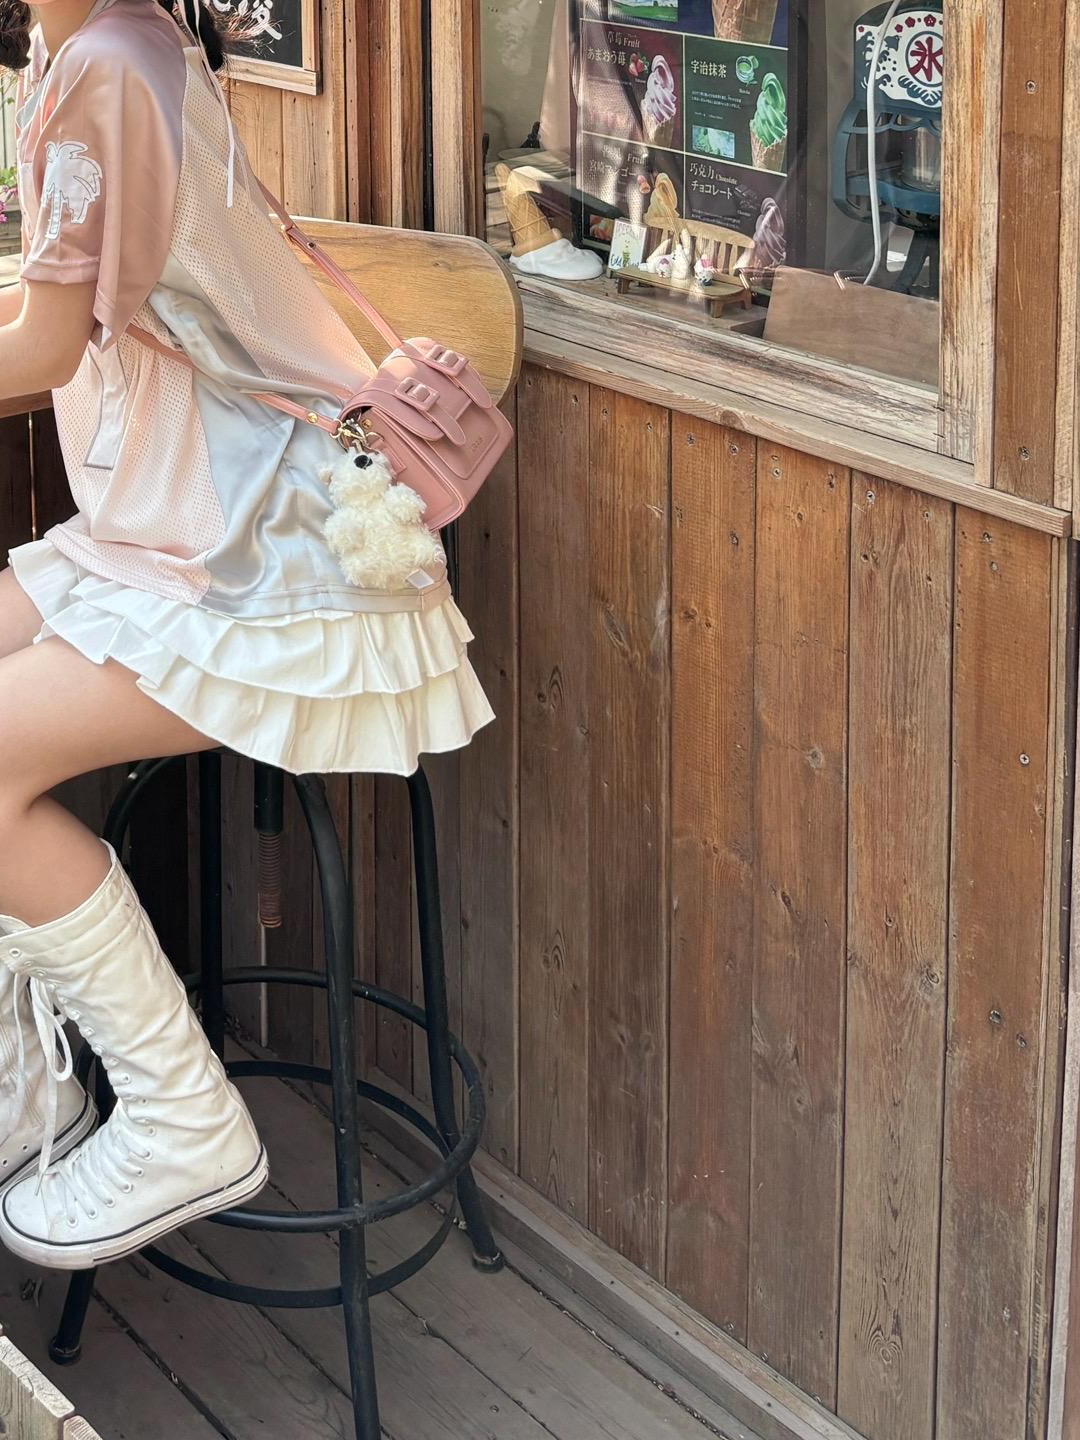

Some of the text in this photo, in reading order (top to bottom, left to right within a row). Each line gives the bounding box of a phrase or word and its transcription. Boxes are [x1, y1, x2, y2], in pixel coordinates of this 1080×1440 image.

[689, 162, 715, 180] 巧克力
[691, 180, 733, 200] チョコレート
